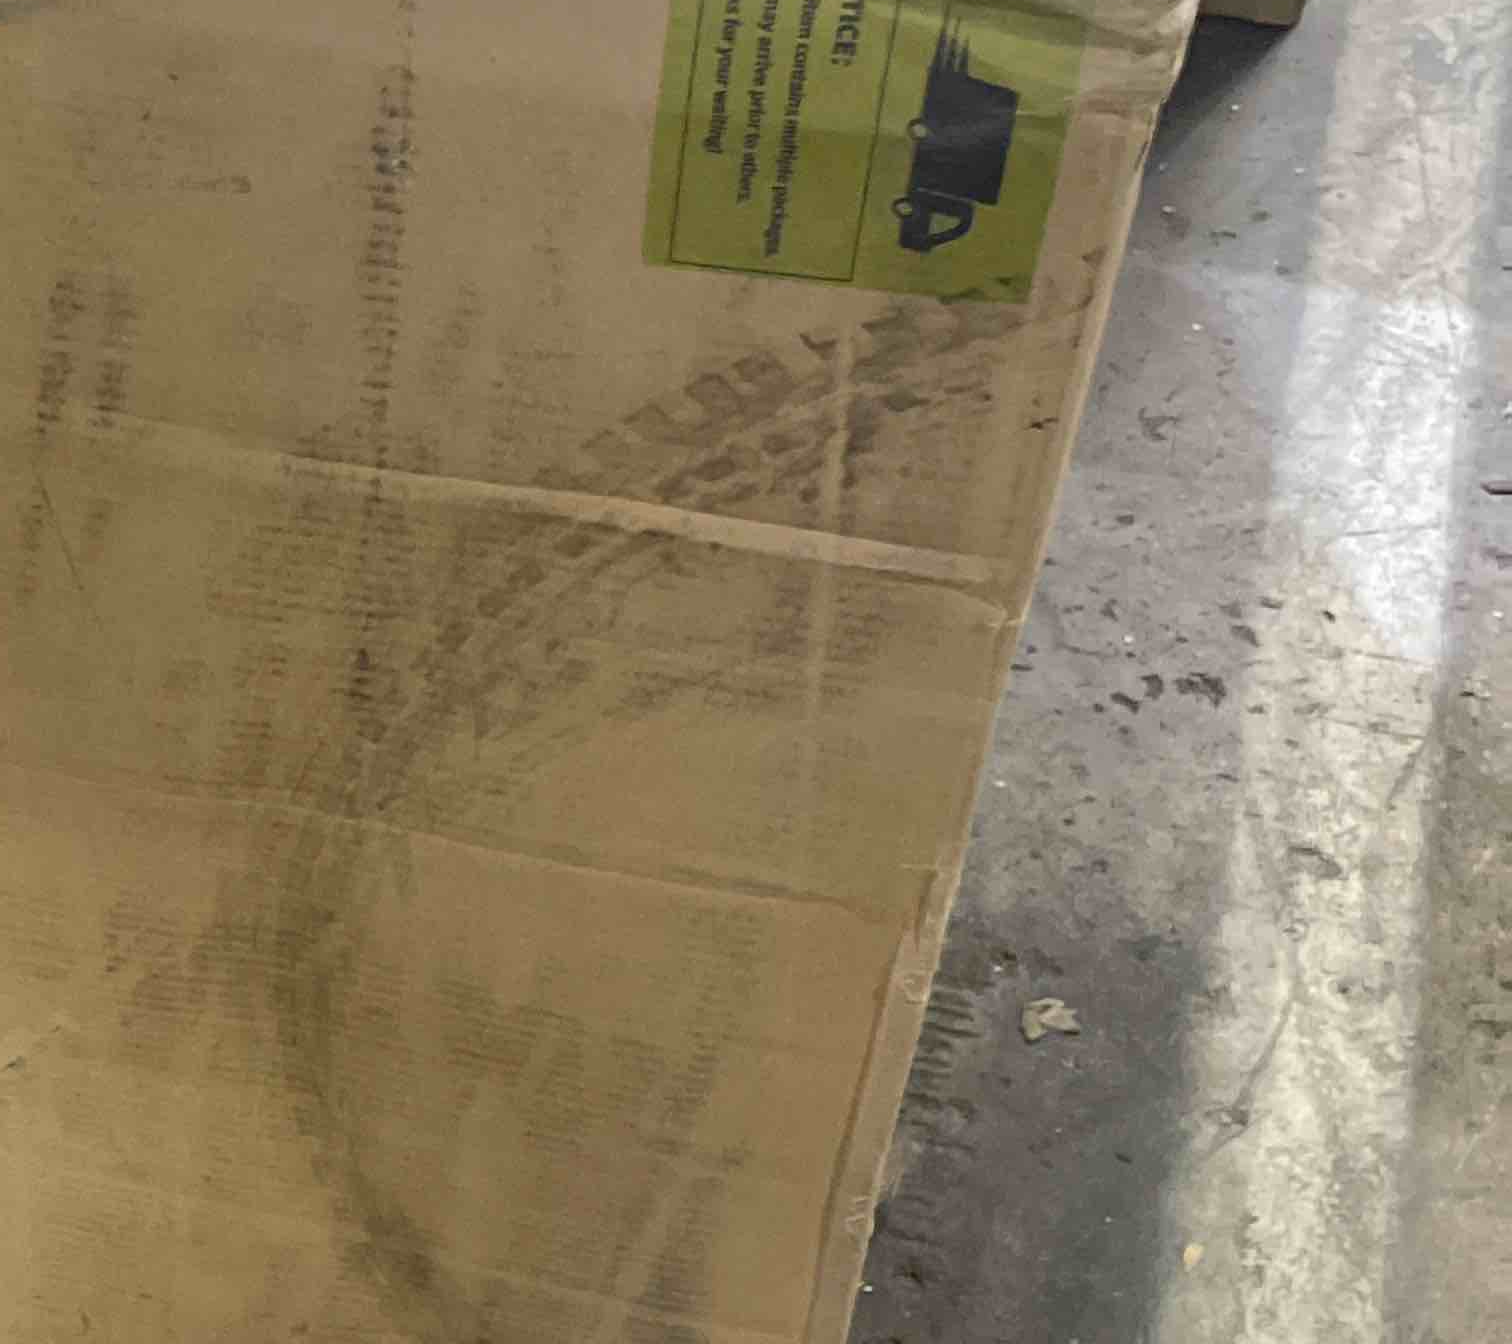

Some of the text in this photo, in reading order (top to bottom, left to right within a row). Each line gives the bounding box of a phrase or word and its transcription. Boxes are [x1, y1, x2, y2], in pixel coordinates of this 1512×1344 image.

[720, 18, 743, 42] for
[714, 46, 735, 87] your
[751, 36, 773, 87] arrive
[785, 42, 810, 116] contains
[702, 90, 729, 154] waiting!
[746, 90, 767, 129] prior
[743, 132, 762, 150] to
[775, 118, 801, 183] multiple
